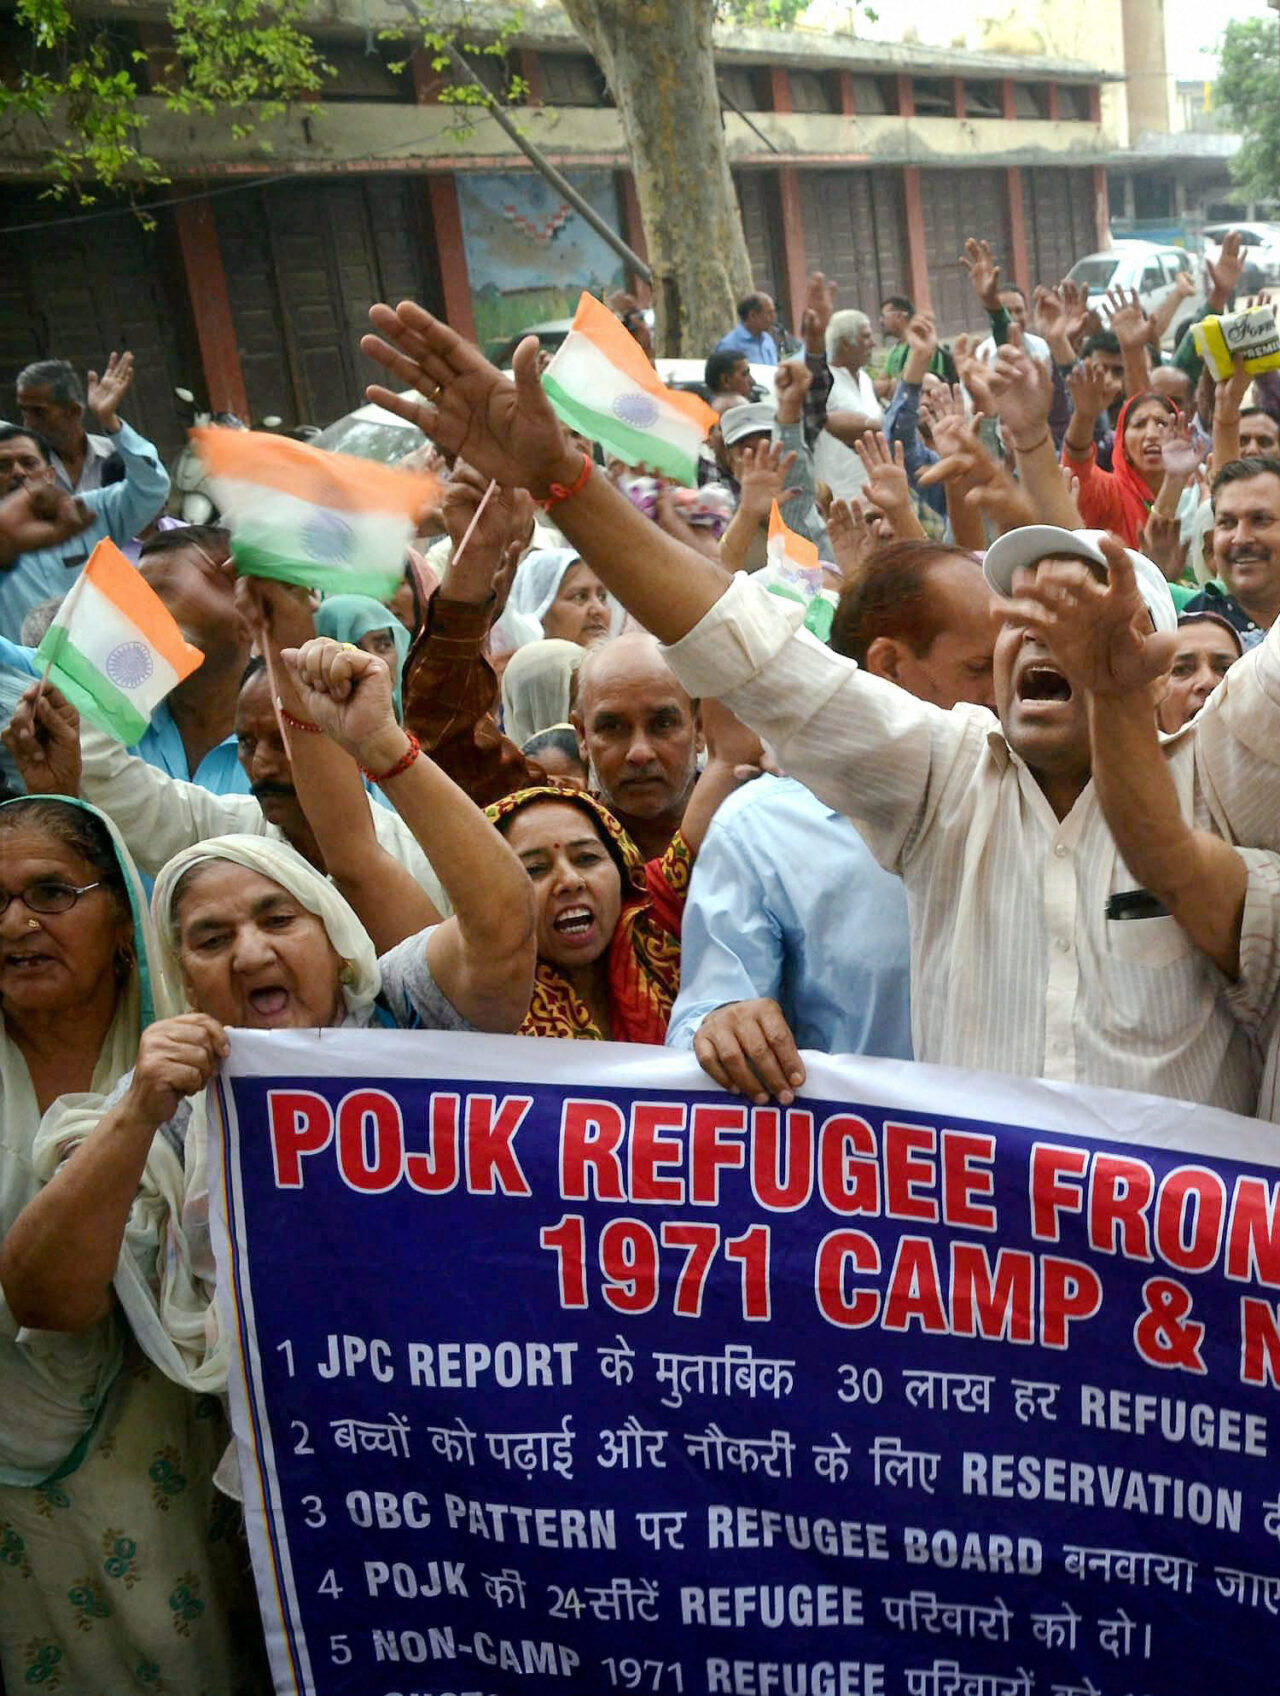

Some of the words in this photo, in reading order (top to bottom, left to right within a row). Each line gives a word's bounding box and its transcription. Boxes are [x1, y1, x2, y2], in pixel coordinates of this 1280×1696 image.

[267, 1089, 533, 1196] POJK
[559, 1098, 998, 1232] REFUGEE
[540, 1215, 773, 1321] 1971
[815, 1229, 1103, 1350] CAMP
[1133, 1276, 1208, 1375] &
[277, 1340, 294, 1377] 1
[318, 1335, 393, 1382] JPC
[408, 1342, 578, 1387] REPORT
[597, 1335, 635, 1385] के
[652, 1345, 795, 1408] मुताबिक
[838, 1365, 882, 1404] 30
[902, 1370, 995, 1413] लाख
[1011, 1379, 1060, 1421] हर
[1082, 1384, 1267, 1456] REFUGEE
[291, 1421, 314, 1454] 2
[330, 1412, 410, 1458] बच्चों
[427, 1417, 476, 1465] को
[485, 1415, 575, 1480] पढ़ाई
[597, 1416, 668, 1468] और
[684, 1423, 796, 1477] नौकरी
[812, 1433, 851, 1482] के
[869, 1437, 941, 1493] लिए
[963, 1452, 1242, 1532] RESERVATION
[302, 1495, 326, 1528] 3
[346, 1491, 430, 1528] OBC
[445, 1494, 616, 1549] PATTERN
[636, 1512, 687, 1550] पर
[708, 1506, 889, 1559] REFUGEE
[904, 1527, 1042, 1574] BOARD
[1063, 1545, 1197, 1593] बनवाया
[318, 1569, 343, 1599] 4
[365, 1561, 468, 1598] POJK
[481, 1569, 526, 1608] की
[681, 1585, 863, 1627] REFUGEE
[1031, 1602, 1081, 1650] को
[330, 1635, 352, 1664] 5
[372, 1626, 579, 1676] NON-CAMP
[602, 1658, 683, 1692] 1971
[707, 1658, 884, 1696] REFUGEE
